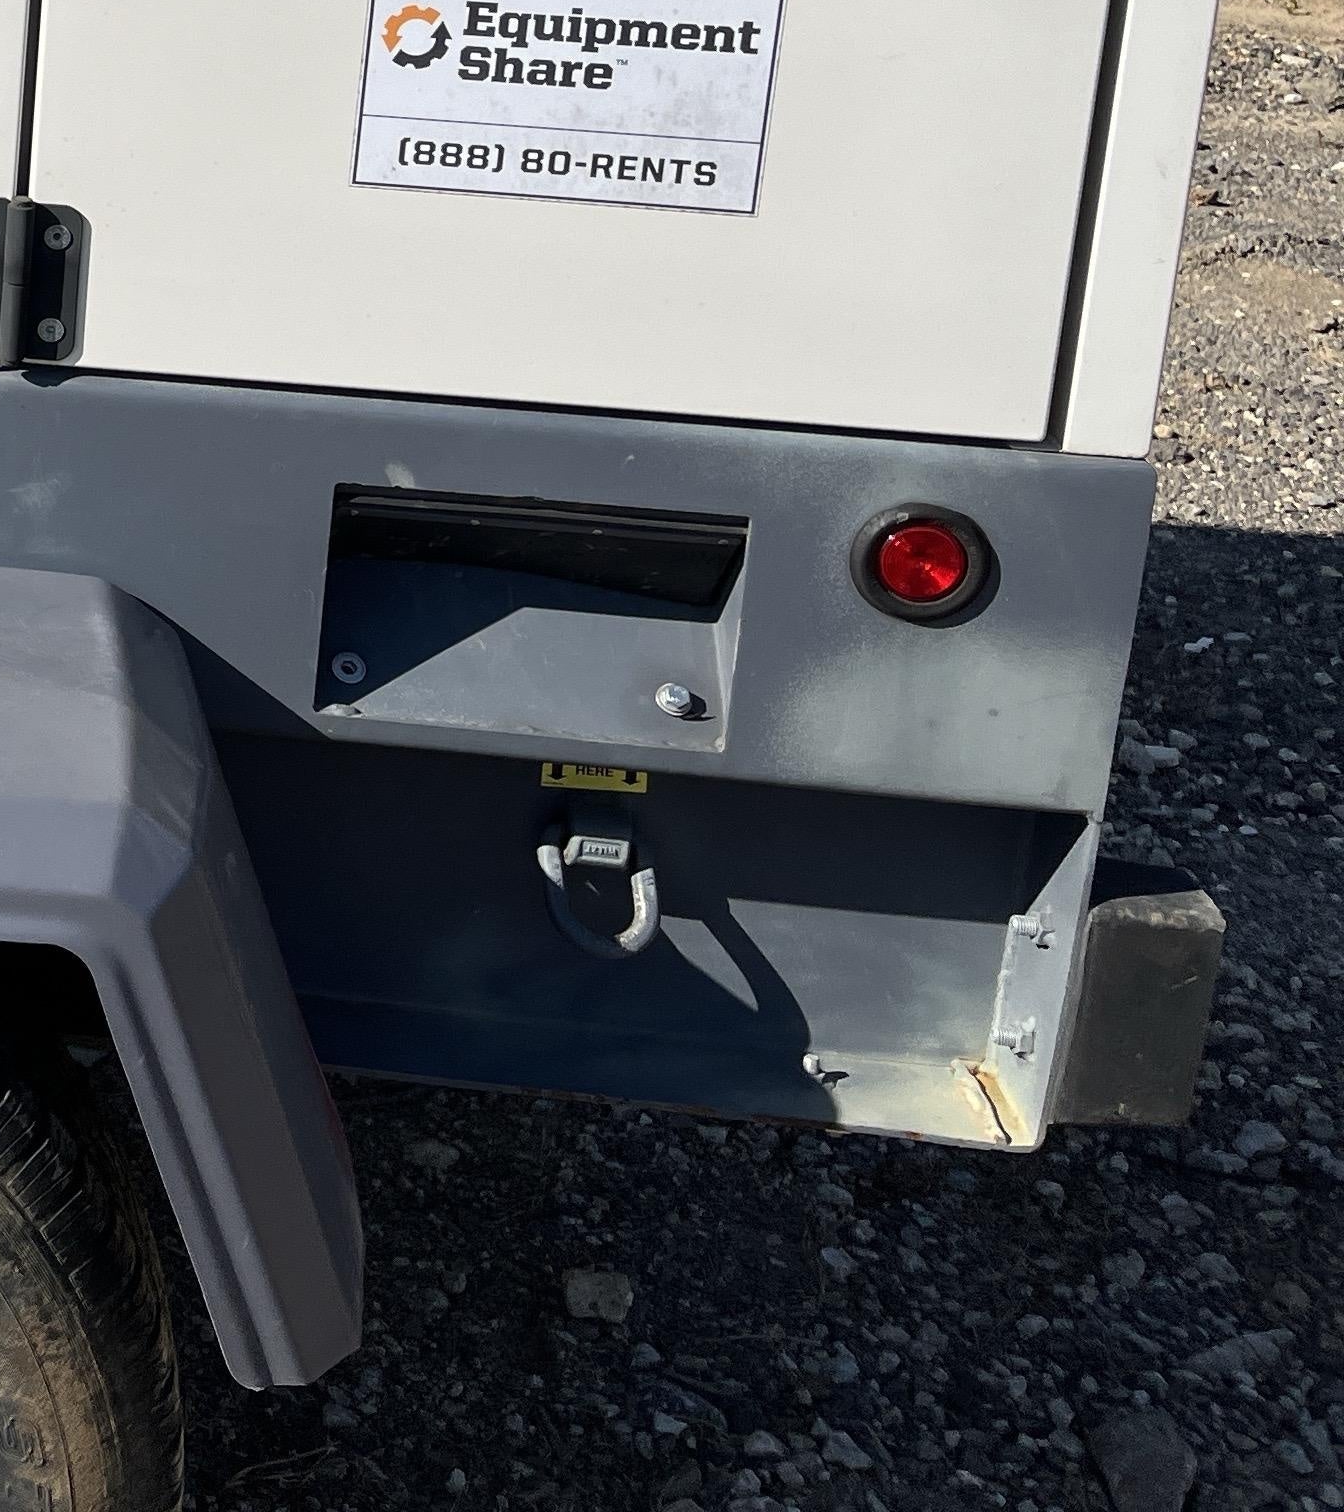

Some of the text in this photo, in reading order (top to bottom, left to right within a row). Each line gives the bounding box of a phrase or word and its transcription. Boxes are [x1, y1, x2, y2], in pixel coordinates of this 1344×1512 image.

[463, 1, 761, 55] Equipment
[458, 45, 613, 90] Share
[398, 137, 718, 187] (888) 80-RENTS
[576, 766, 614, 777] HERE
